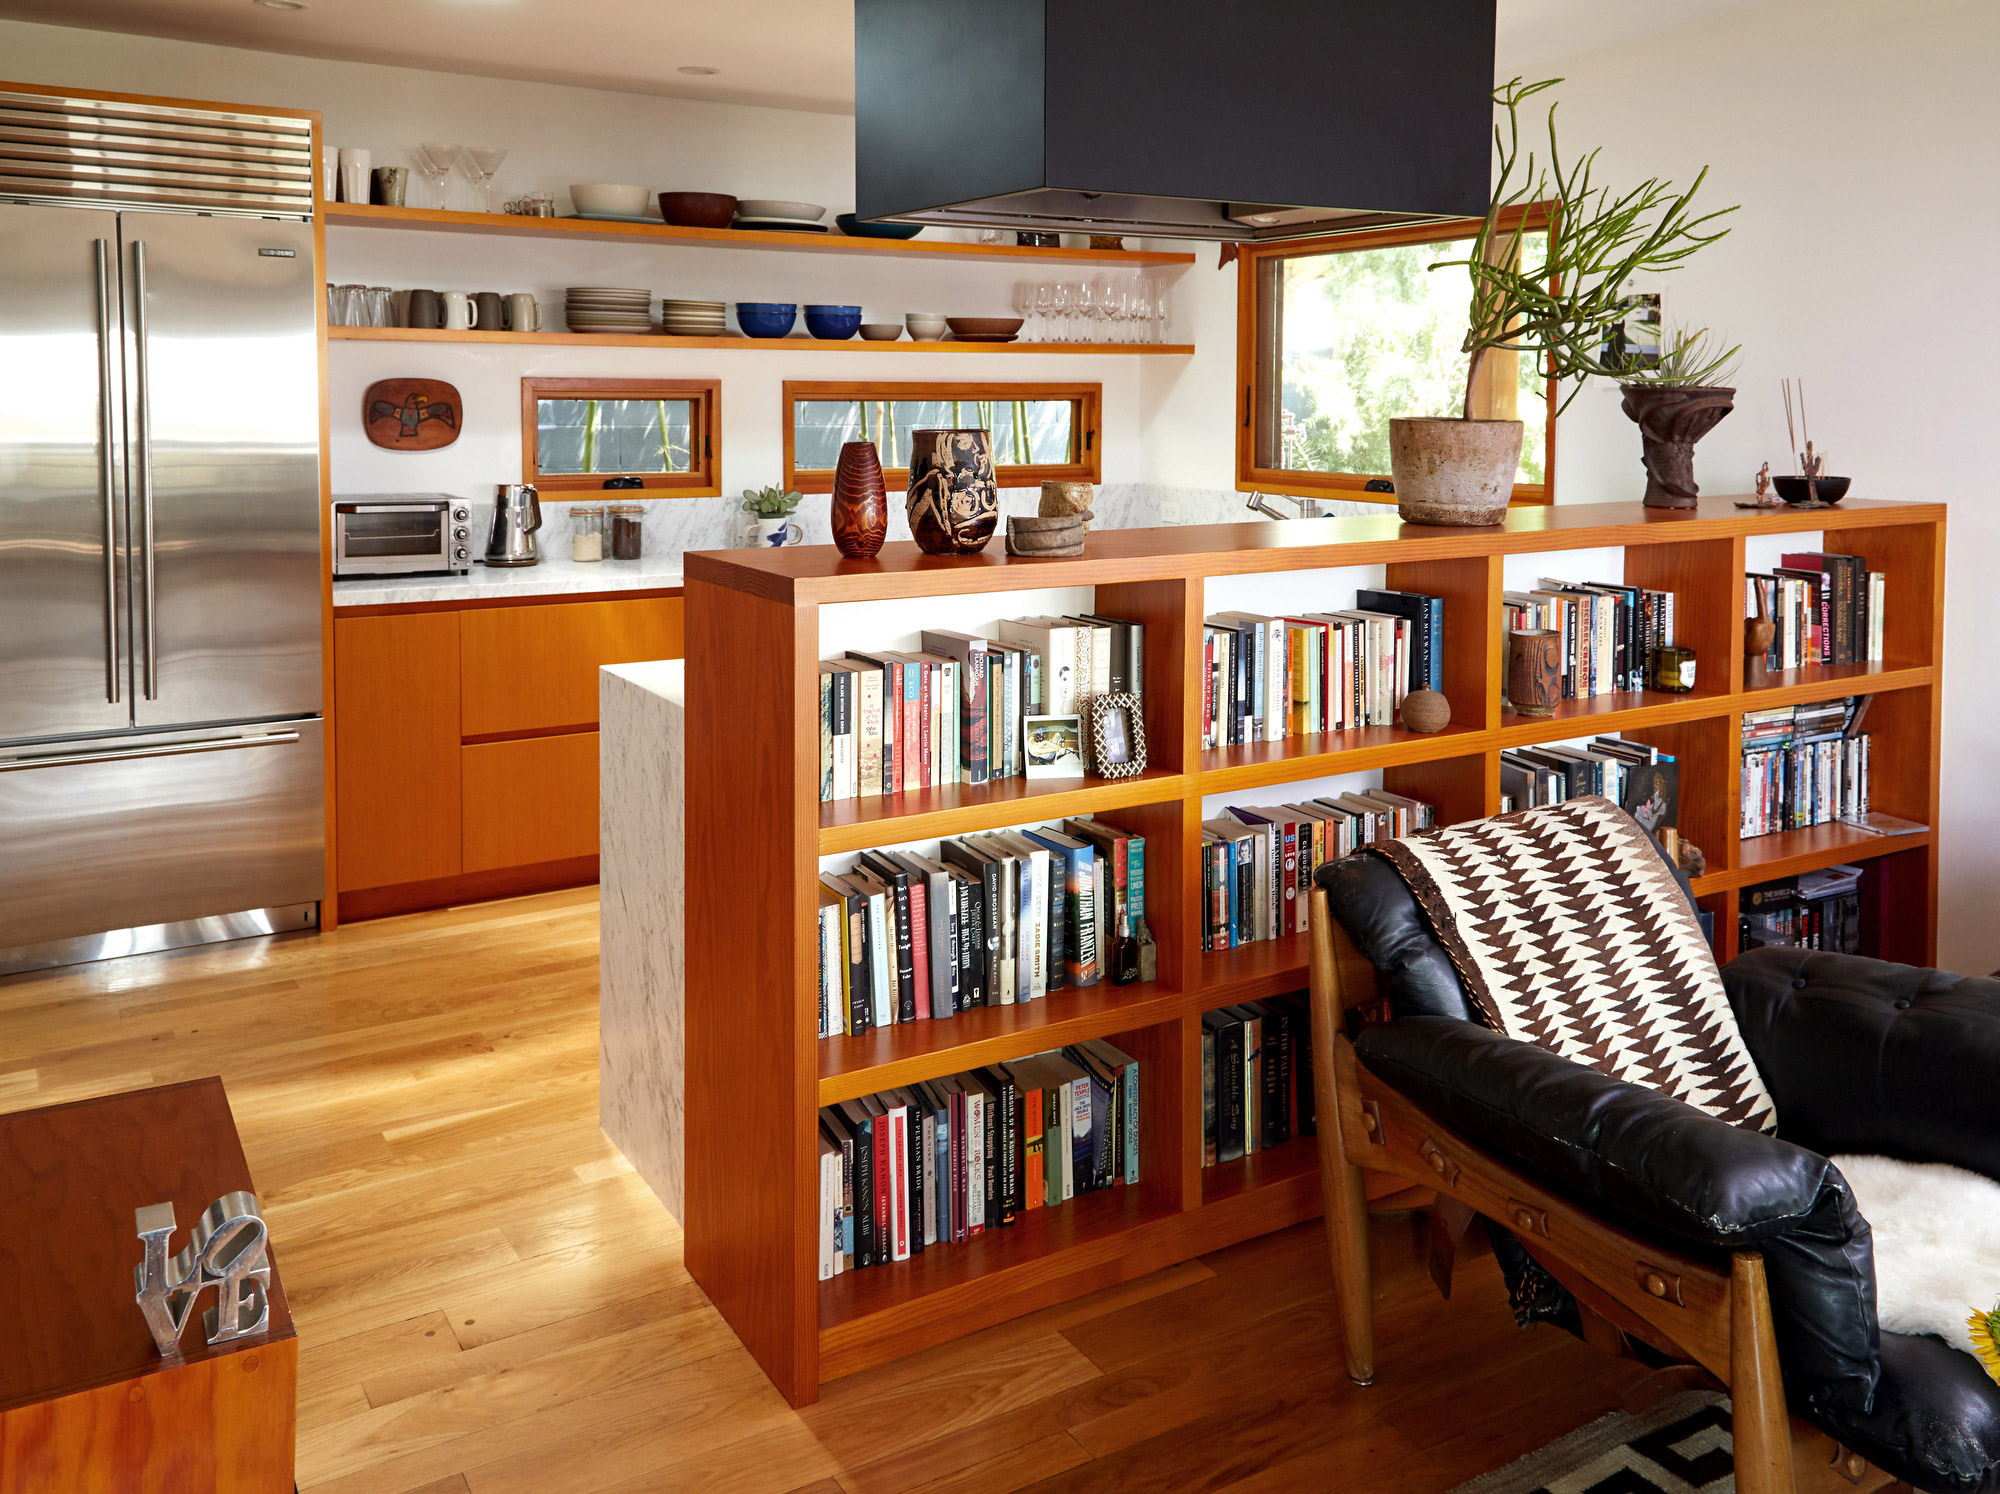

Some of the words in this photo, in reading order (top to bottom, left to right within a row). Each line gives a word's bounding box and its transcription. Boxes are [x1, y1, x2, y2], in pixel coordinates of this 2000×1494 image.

[262, 249, 294, 257] SUB-ZERO
[1433, 614, 1441, 635] LIT
[1821, 601, 1830, 656] CORRECTIONS
[1285, 834, 1295, 842] US
[1079, 871, 1094, 921] JONATHAN
[1130, 880, 1144, 890] UNION
[1763, 890, 1774, 898] THE
[1773, 888, 1791, 897] SHIELD
[1801, 915, 1809, 937] MAD
[1080, 921, 1096, 969] FRANZEN
[1075, 1082, 1089, 1091] PETER
[1230, 1053, 1240, 1101] Suitable
[1073, 1087, 1090, 1097] TEMPLE
[973, 1099, 981, 1138] WOMEN
[987, 1103, 995, 1130] Without
[1230, 1103, 1240, 1130] Boy
[877, 1121, 888, 1156] JOSEPH
[986, 1130, 995, 1159] Stopping
[860, 1145, 869, 1177] JOSEPH
[987, 1165, 995, 1179] Paul
[879, 1159, 888, 1195] KANON
